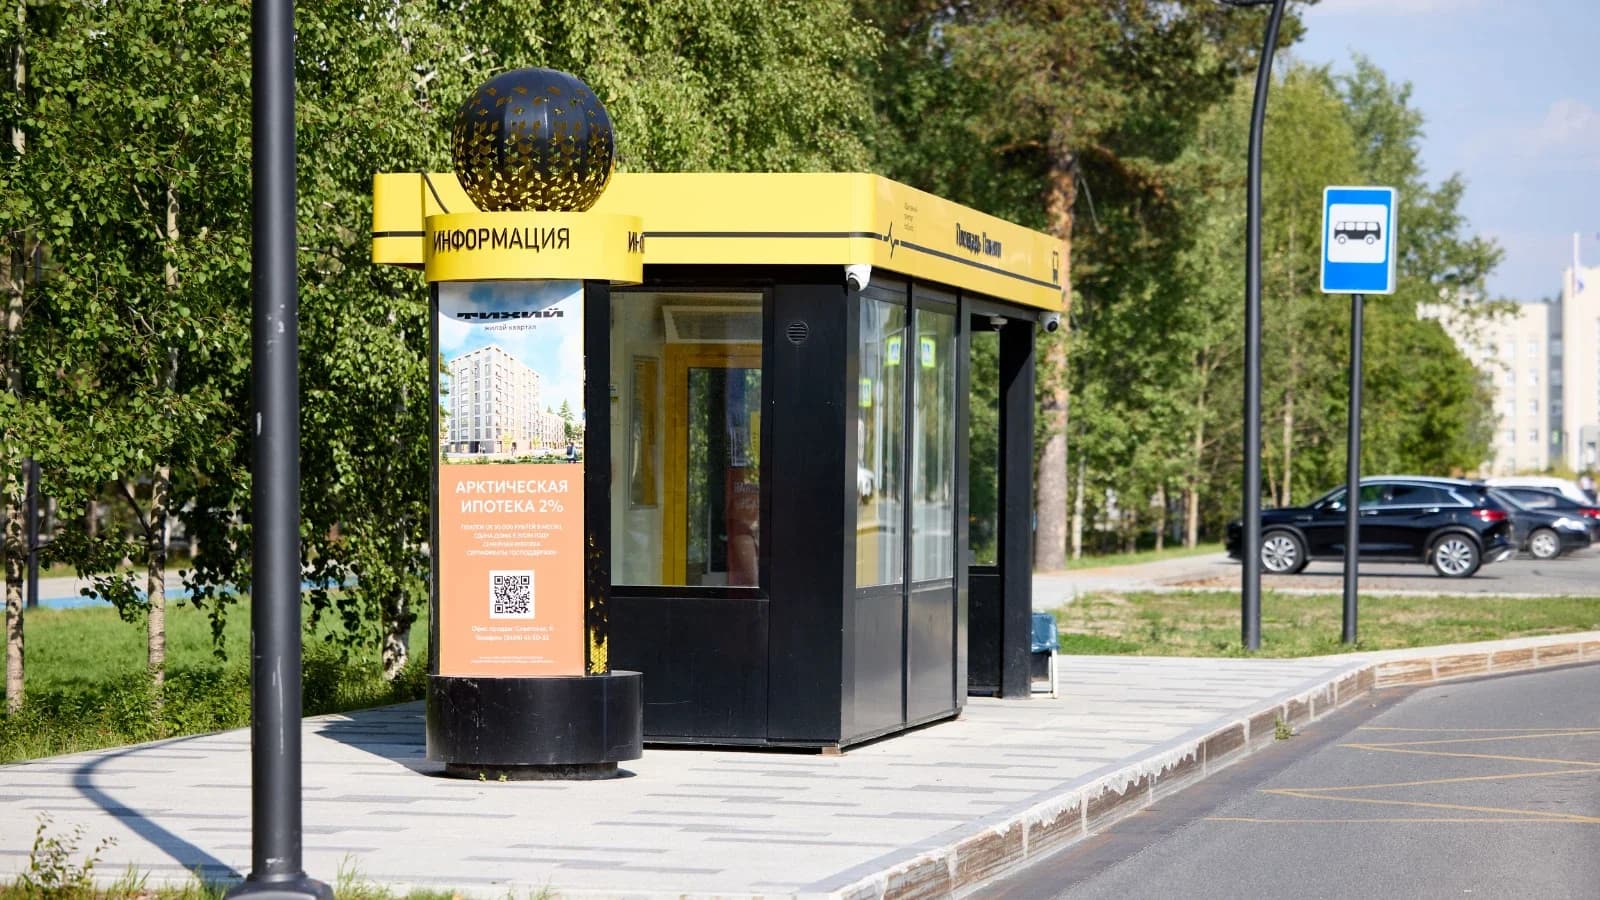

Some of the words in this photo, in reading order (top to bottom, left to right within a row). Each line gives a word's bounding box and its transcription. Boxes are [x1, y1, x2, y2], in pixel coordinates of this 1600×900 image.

[433, 227, 570, 252] ИНФОРМАЦИЯ
[455, 480, 568, 494] АРКТИЧЕСКАЯ
[461, 500, 535, 513] ИПОТЕКА
[539, 499, 564, 513] 2%
